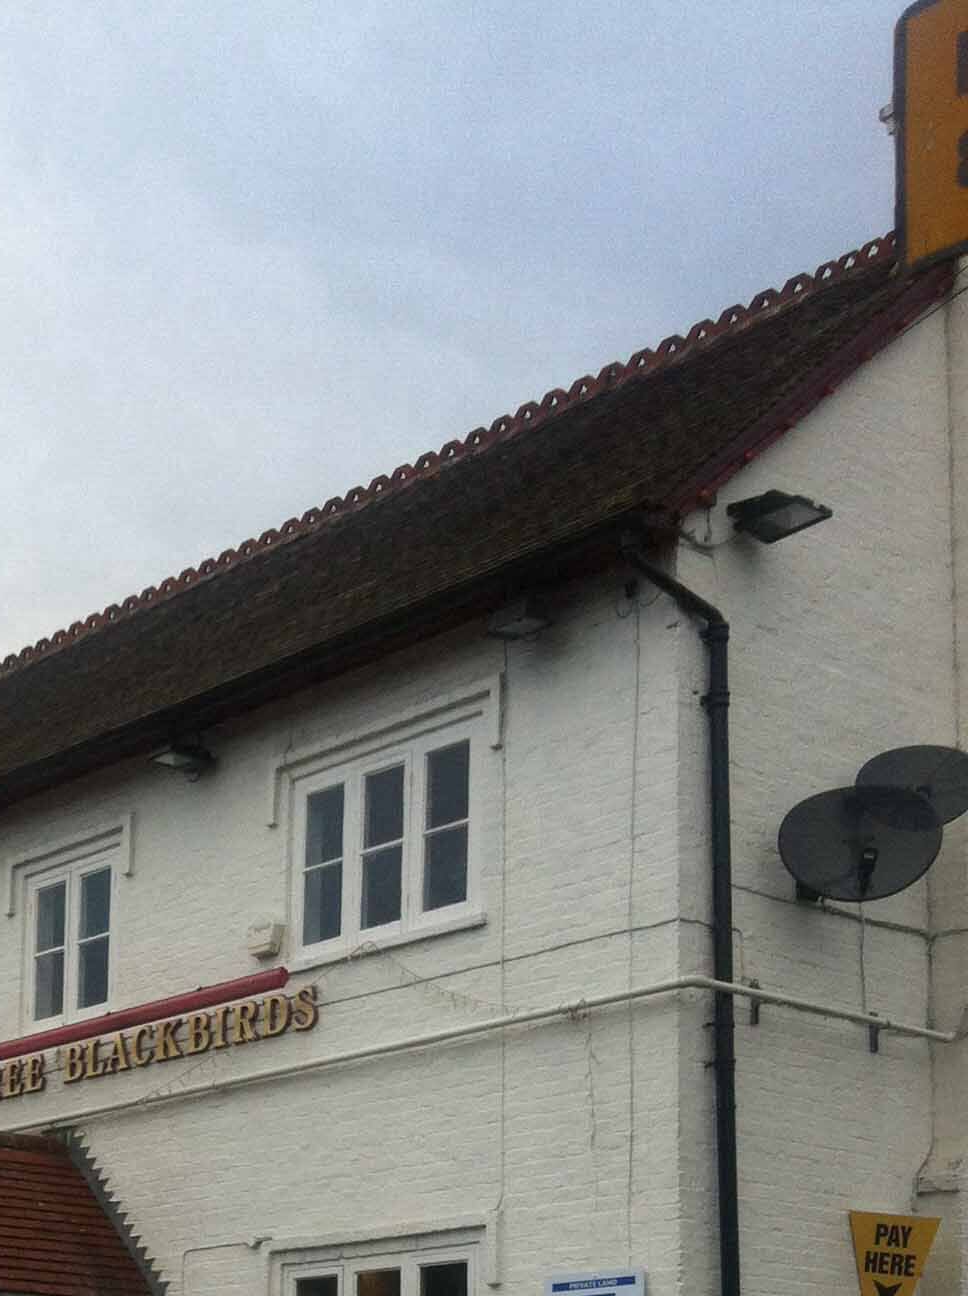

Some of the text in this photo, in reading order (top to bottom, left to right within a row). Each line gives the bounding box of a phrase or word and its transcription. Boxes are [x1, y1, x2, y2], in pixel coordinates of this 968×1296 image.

[63, 986, 318, 1083] BLACKBIRDS
[874, 1224, 912, 1248] PAY
[865, 1251, 916, 1276] HERE
